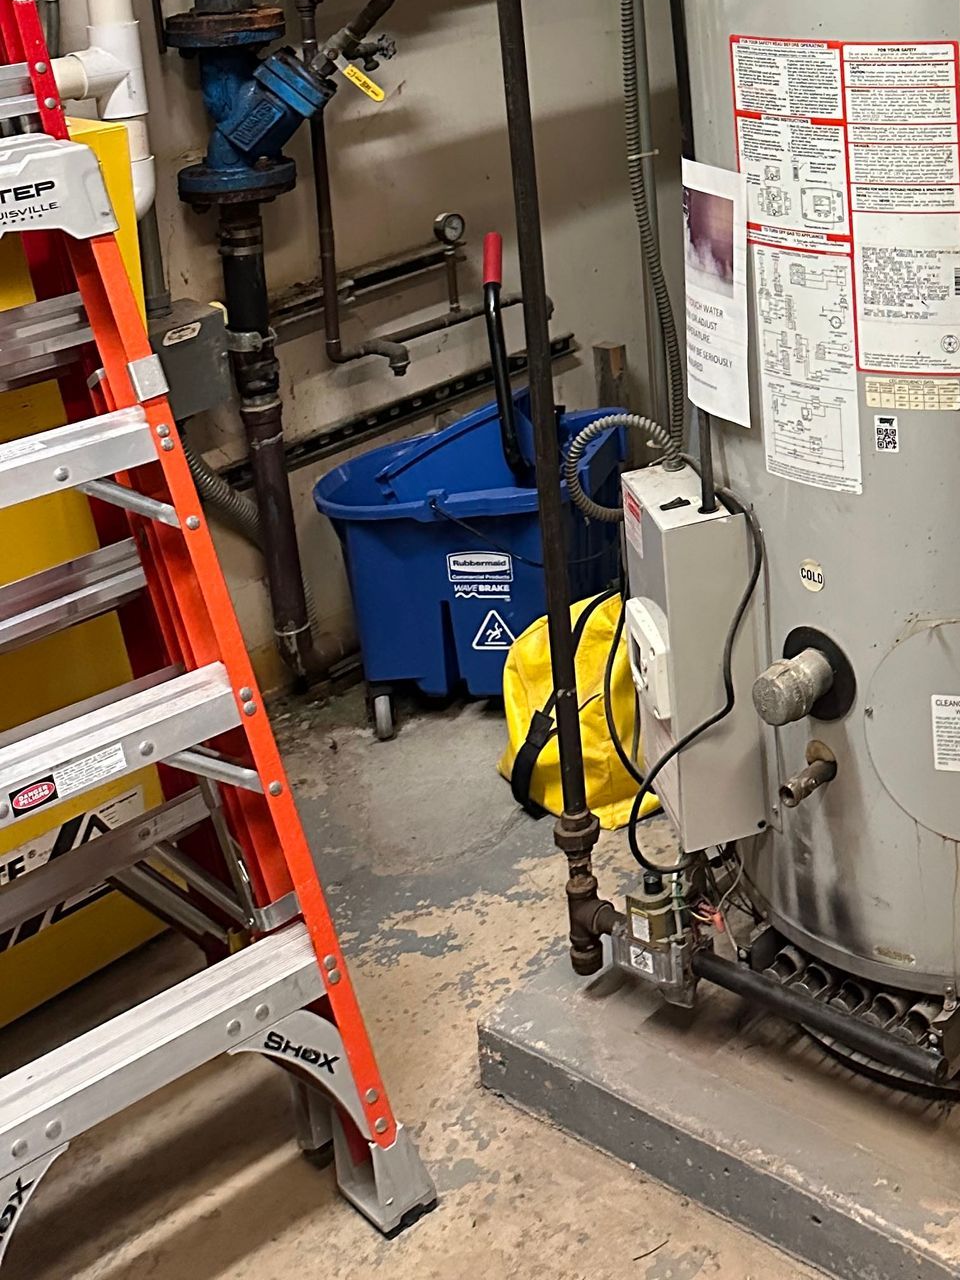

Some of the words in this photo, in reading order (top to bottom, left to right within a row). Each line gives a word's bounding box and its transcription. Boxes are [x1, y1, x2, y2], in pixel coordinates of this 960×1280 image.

[703, 303, 724, 318] WATER
[702, 350, 733, 369] SERIOUSLY
[452, 559, 507, 567] Rubbermaid
[800, 567, 823, 584] COLD
[18, 784, 49, 801] DANGER
[19, 789, 50, 807] PELIGRO
[264, 1031, 340, 1075] SHOX
